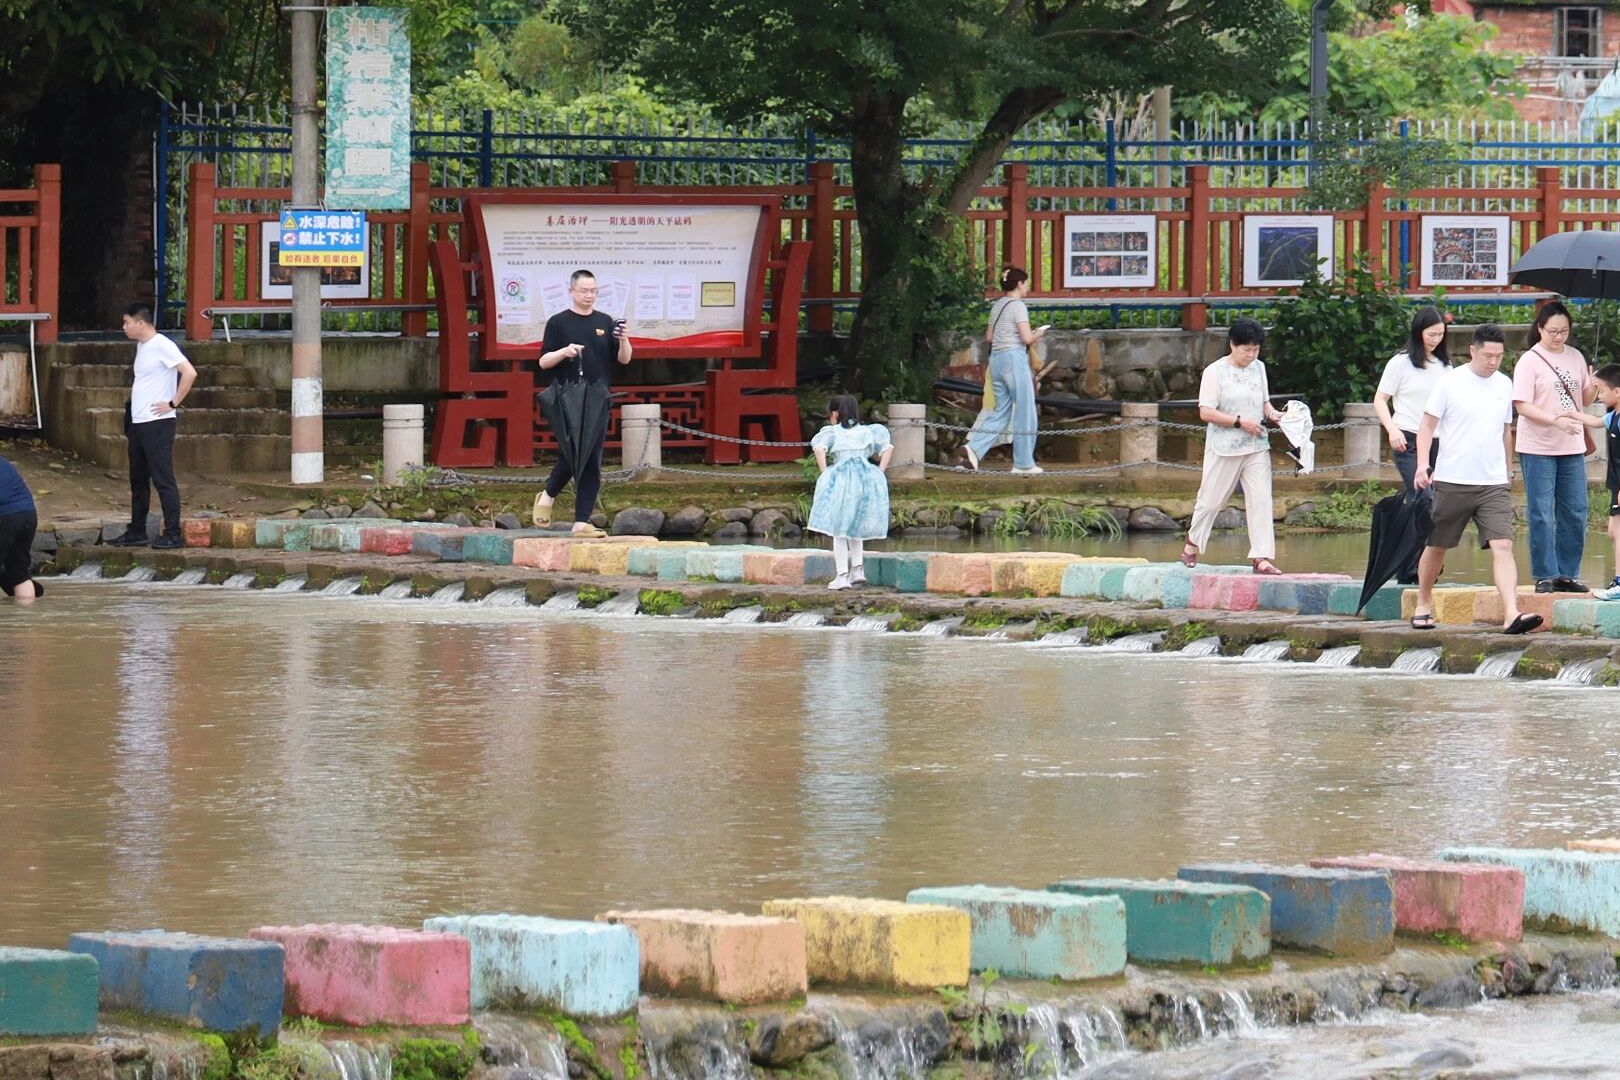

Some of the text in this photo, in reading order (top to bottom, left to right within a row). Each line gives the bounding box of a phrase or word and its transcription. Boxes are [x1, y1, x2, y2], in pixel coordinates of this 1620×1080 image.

[299, 215, 360, 229] 水深危险!
[299, 231, 360, 245] 禁止下水!
[323, 255, 358, 263] 后果自负
